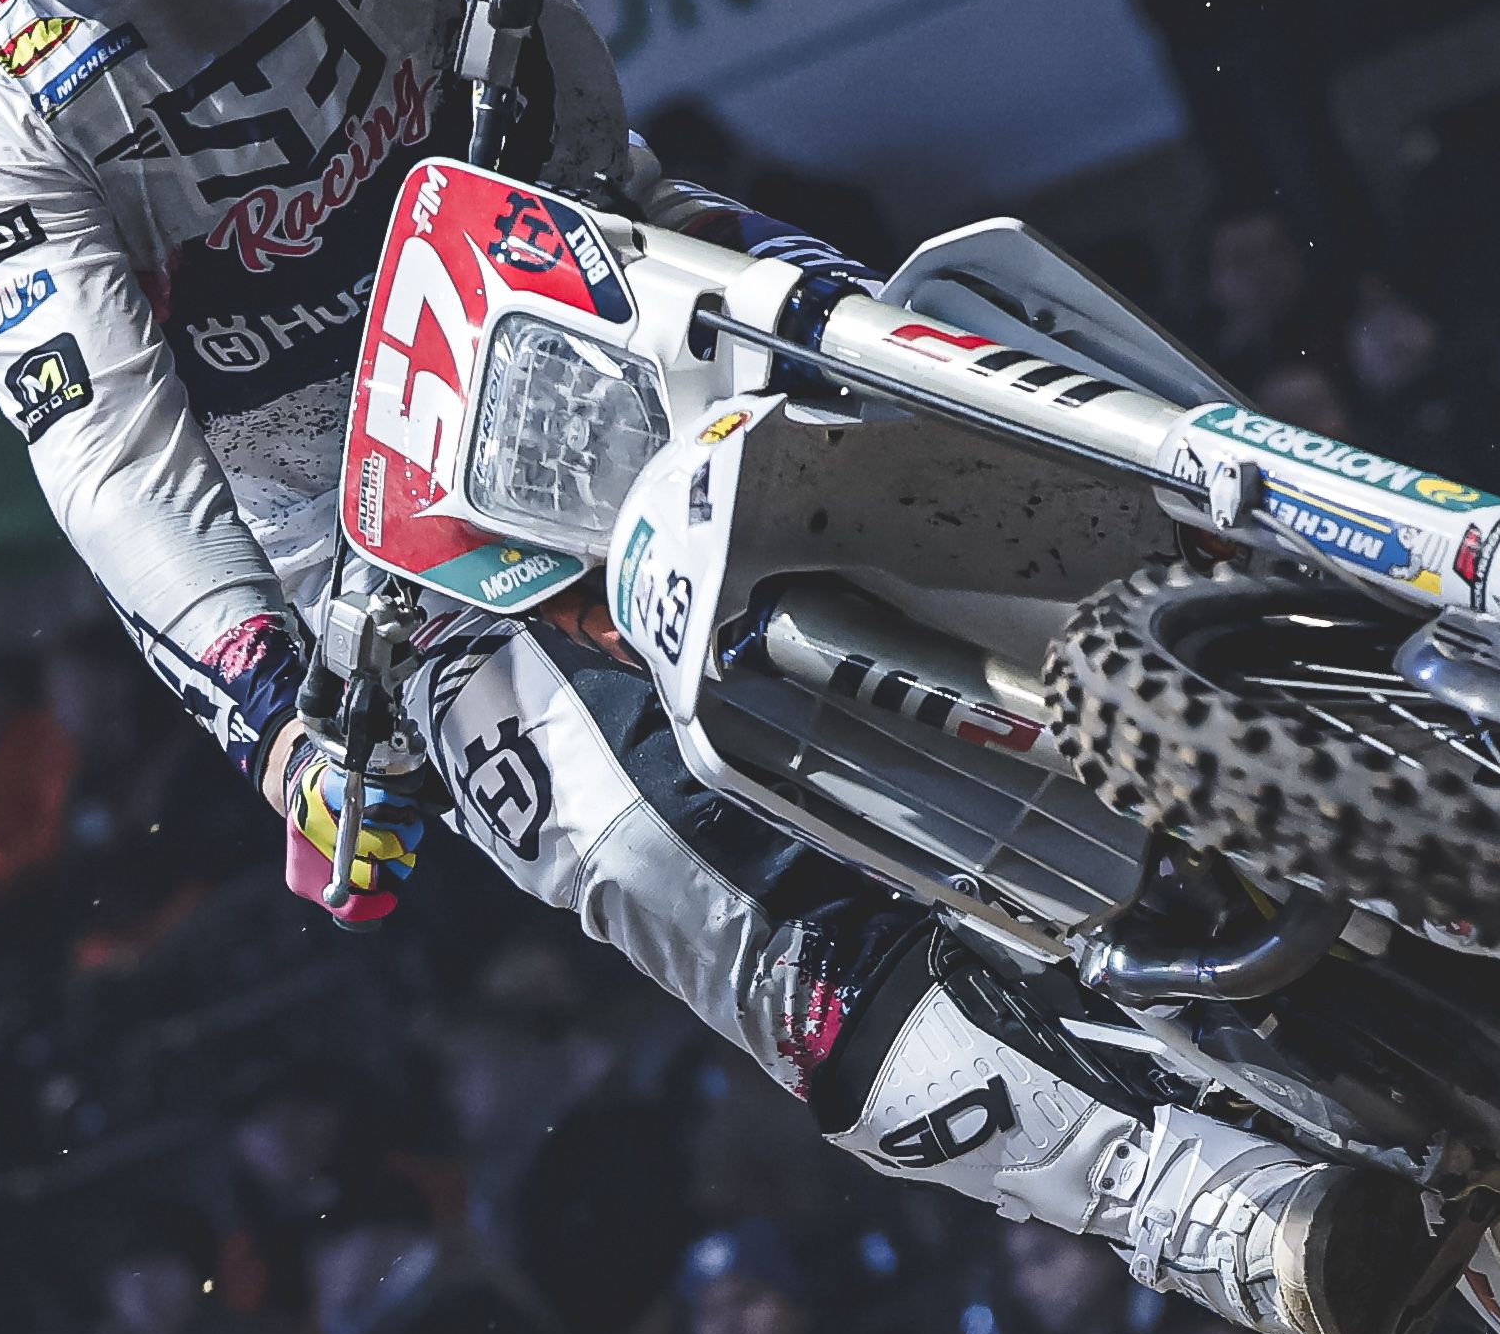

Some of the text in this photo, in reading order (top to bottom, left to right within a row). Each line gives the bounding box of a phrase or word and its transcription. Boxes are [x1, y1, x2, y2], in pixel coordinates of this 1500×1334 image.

[55, 34, 133, 100] MICHELIN
[205, 56, 441, 272] Racing
[411, 165, 449, 237] FIM
[564, 224, 611, 286] BOLT
[364, 236, 472, 496] 57
[1215, 410, 1422, 490] MOTOREX
[367, 454, 381, 545] ENDURO
[480, 553, 561, 602] MOTOREX
